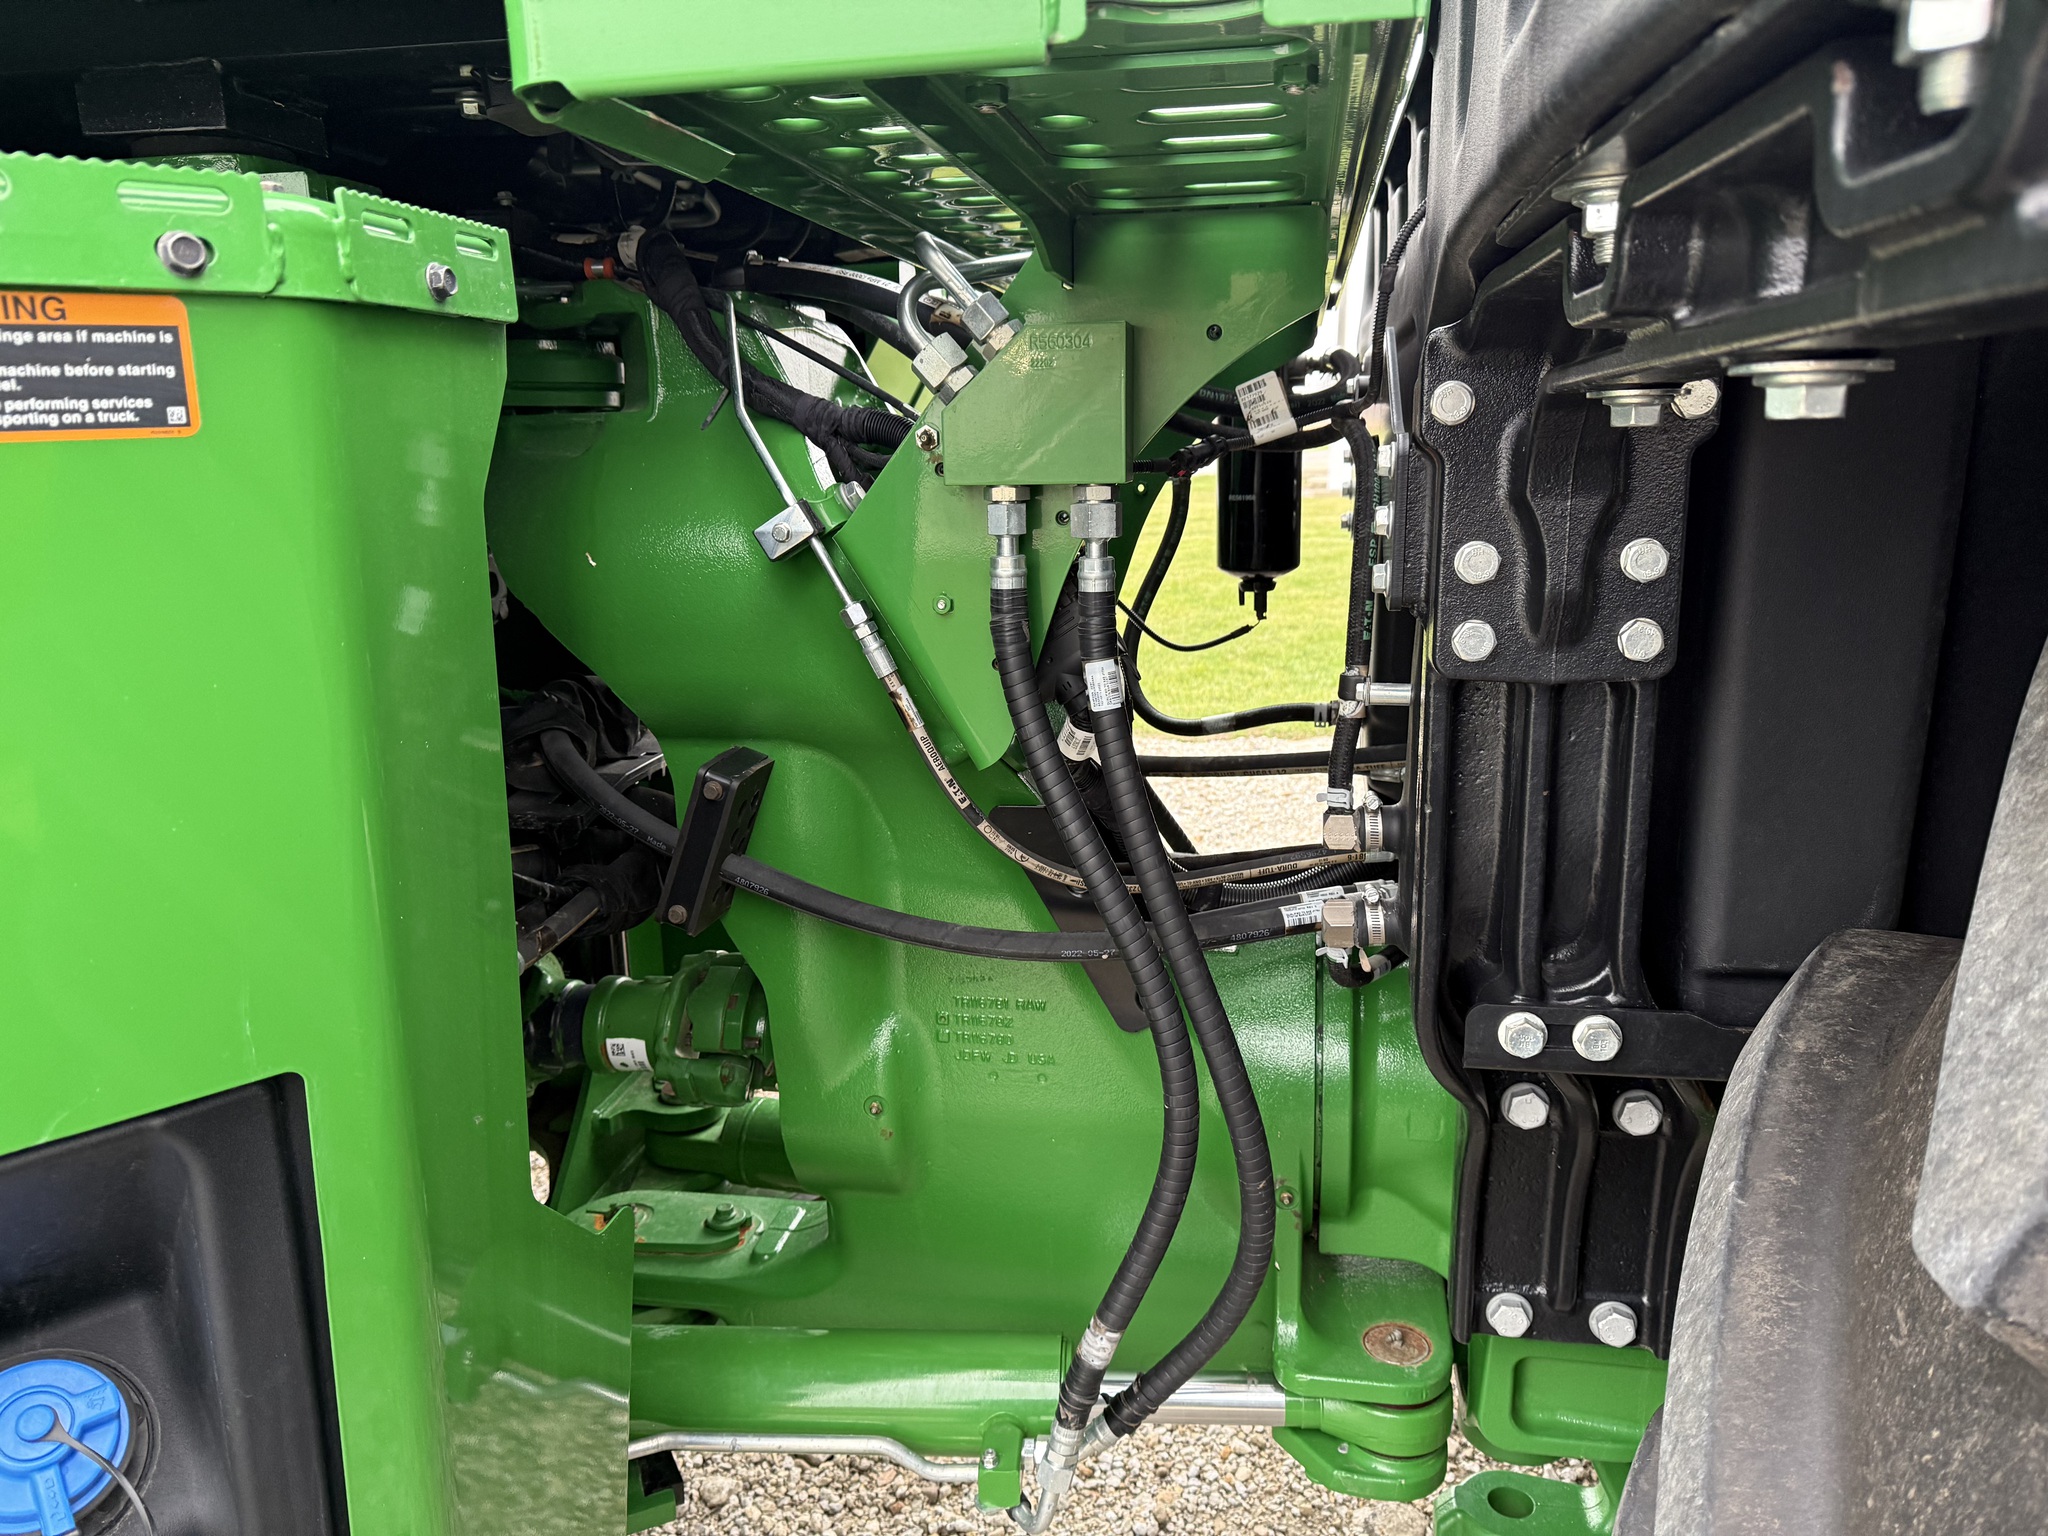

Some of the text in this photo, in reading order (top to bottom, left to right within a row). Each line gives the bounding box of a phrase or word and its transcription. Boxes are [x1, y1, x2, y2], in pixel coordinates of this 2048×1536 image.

[37, 331, 72, 343] area
[76, 329, 88, 343] if
[91, 330, 156, 344] machine
[159, 331, 174, 344] is
[1029, 331, 1093, 350] R560304
[64, 363, 114, 377] before
[117, 363, 176, 378] starting
[4, 396, 153, 413] performing services
[61, 412, 82, 423] on
[85, 412, 95, 423] a
[98, 409, 140, 423] truck.
[1368, 538, 1377, 567] ESP
[919, 735, 946, 772] AEROQUIP
[646, 835, 667, 850] Made
[734, 876, 770, 896] 4807926
[1230, 929, 1270, 941] 4807926
[1015, 998, 1047, 1012] RAW
[1027, 1053, 1056, 1066] USA
